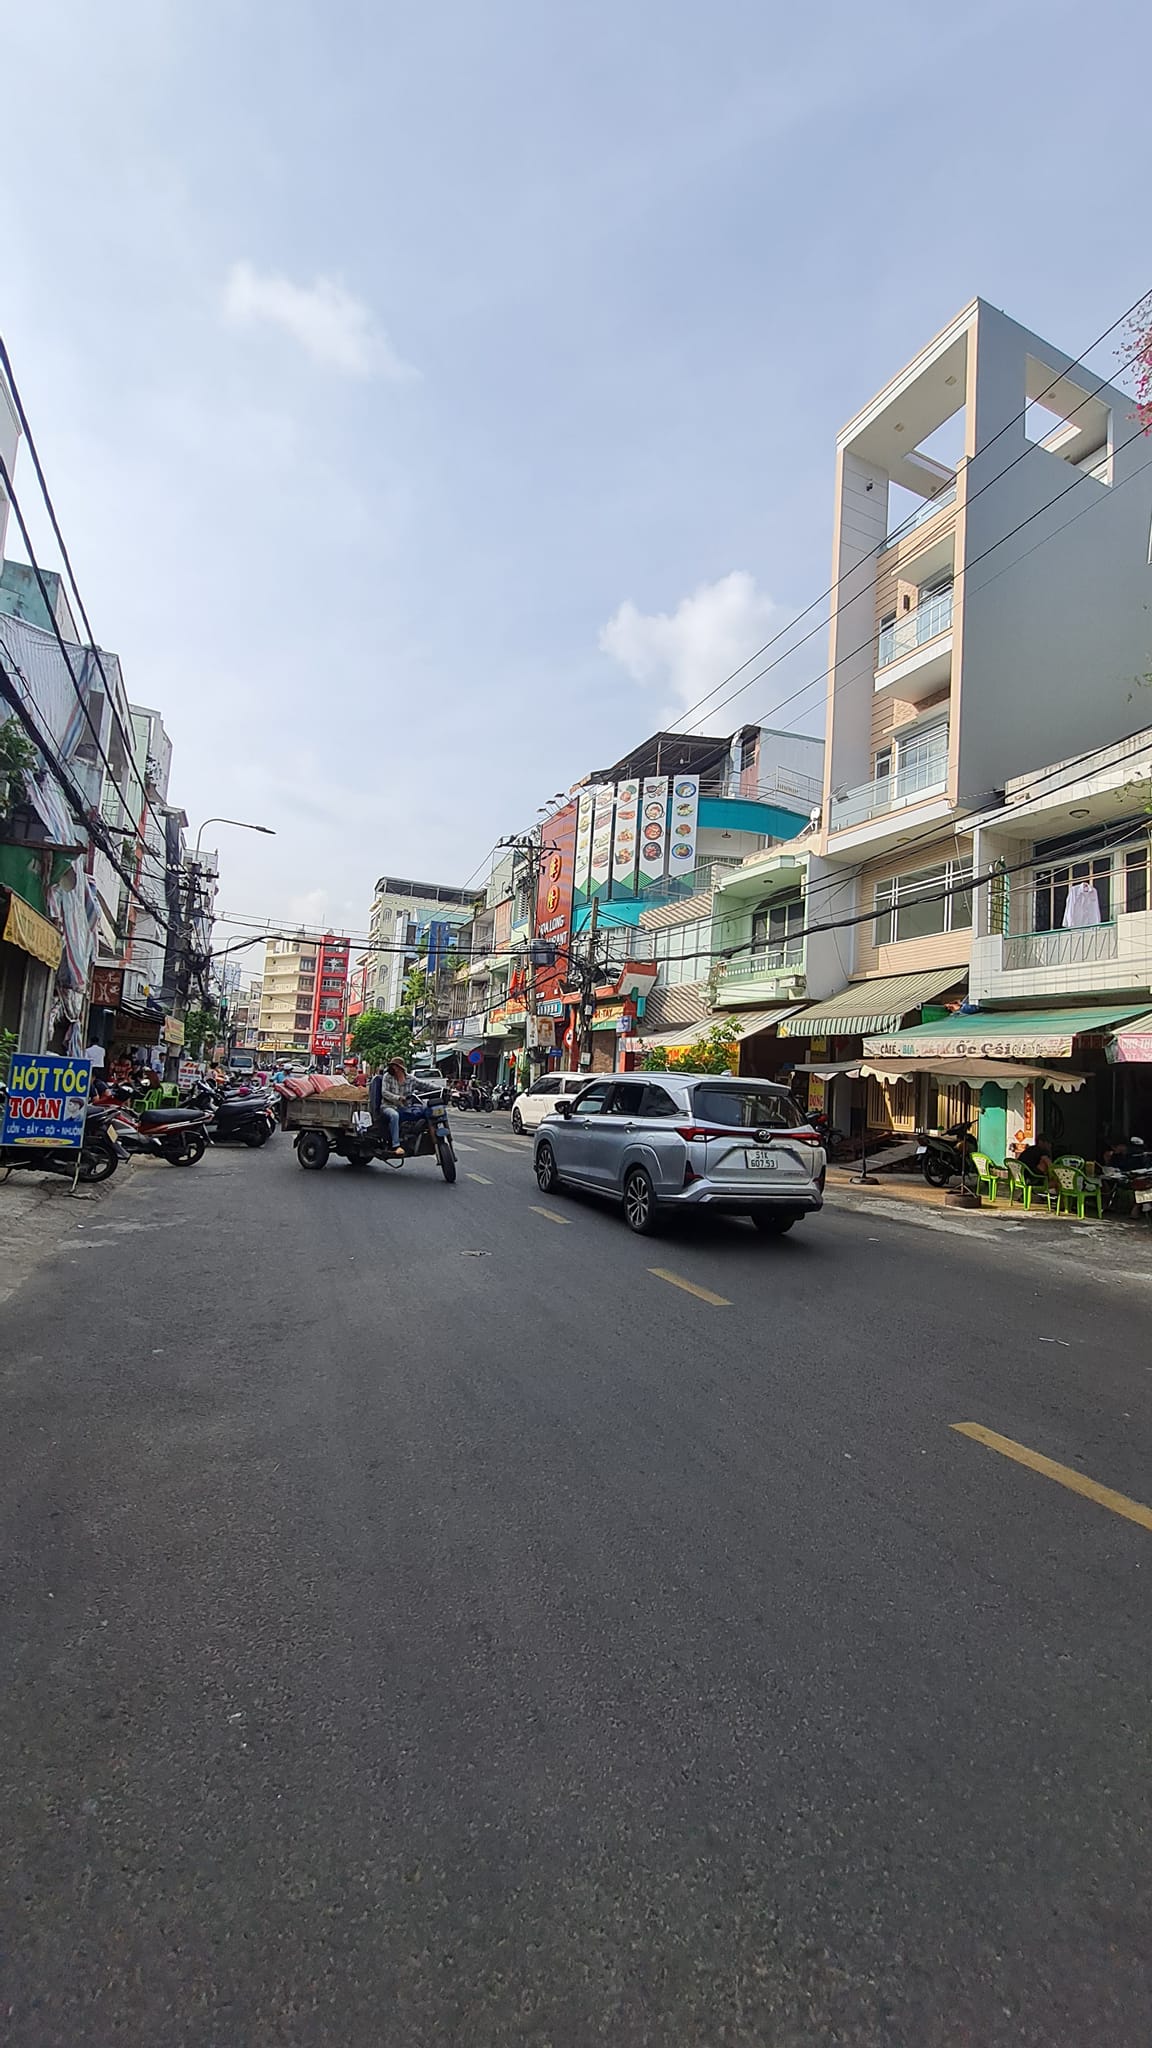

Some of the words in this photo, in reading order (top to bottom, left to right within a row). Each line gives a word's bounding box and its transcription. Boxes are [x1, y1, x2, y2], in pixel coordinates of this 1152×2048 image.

[11, 1060, 50, 1092] HỚT
[53, 1061, 88, 1093] TÓC
[9, 1093, 62, 1120] TOÀN
[755, 1151, 768, 1159] 51K
